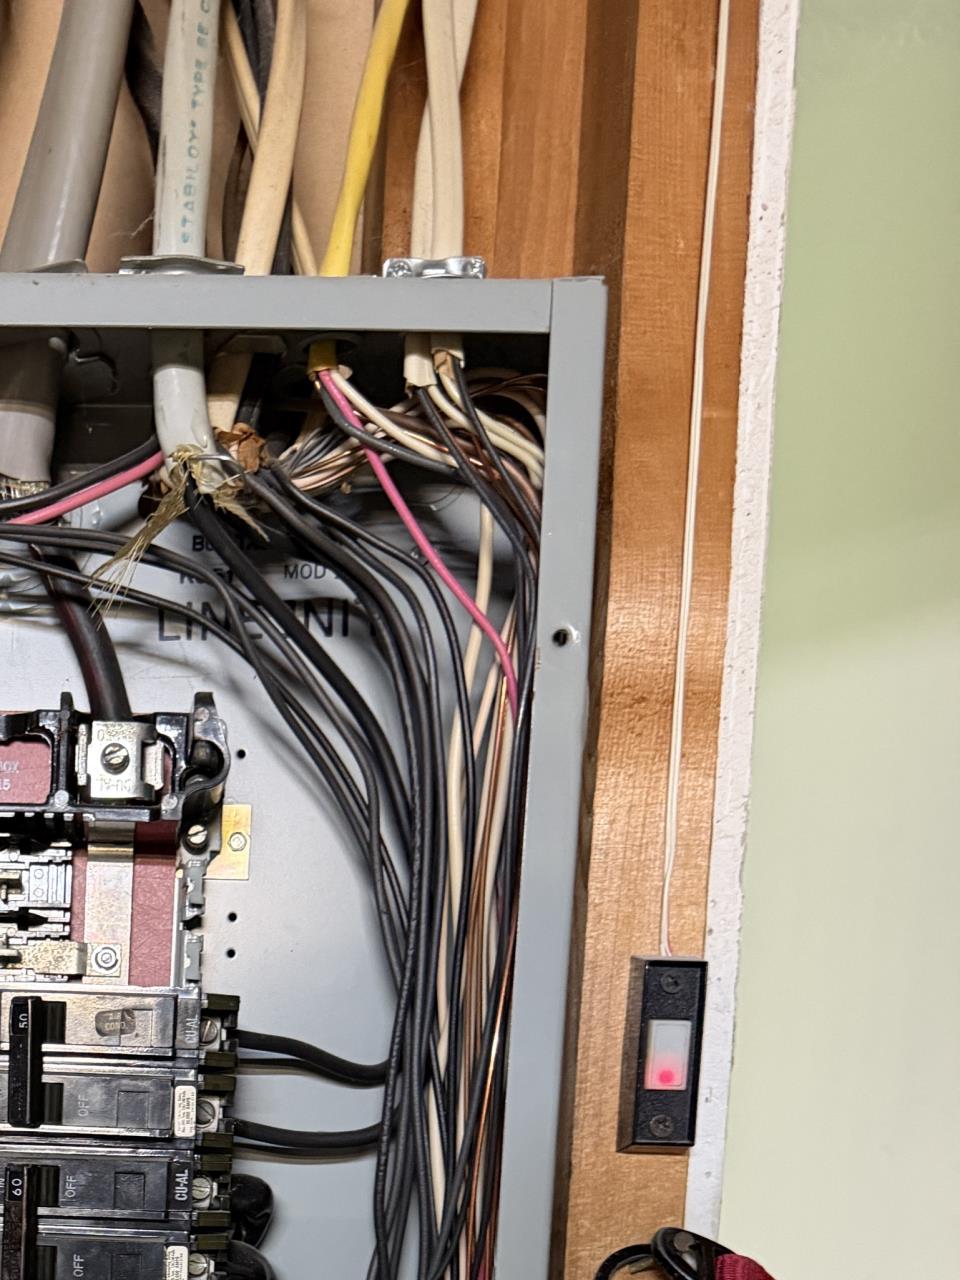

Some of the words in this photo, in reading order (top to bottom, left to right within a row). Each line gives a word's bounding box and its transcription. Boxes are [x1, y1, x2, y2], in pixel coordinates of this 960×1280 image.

[192, 59, 208, 108] TYPE
[283, 564, 326, 580] MOD
[18, 1013, 28, 1029] 50
[185, 1015, 199, 1044] CU-AL
[78, 1094, 89, 1117] OFF
[11, 1178, 22, 1197] 60
[65, 1175, 77, 1198] OFF
[174, 1169, 189, 1201] CU-AL
[72, 1254, 85, 1278] OFF
